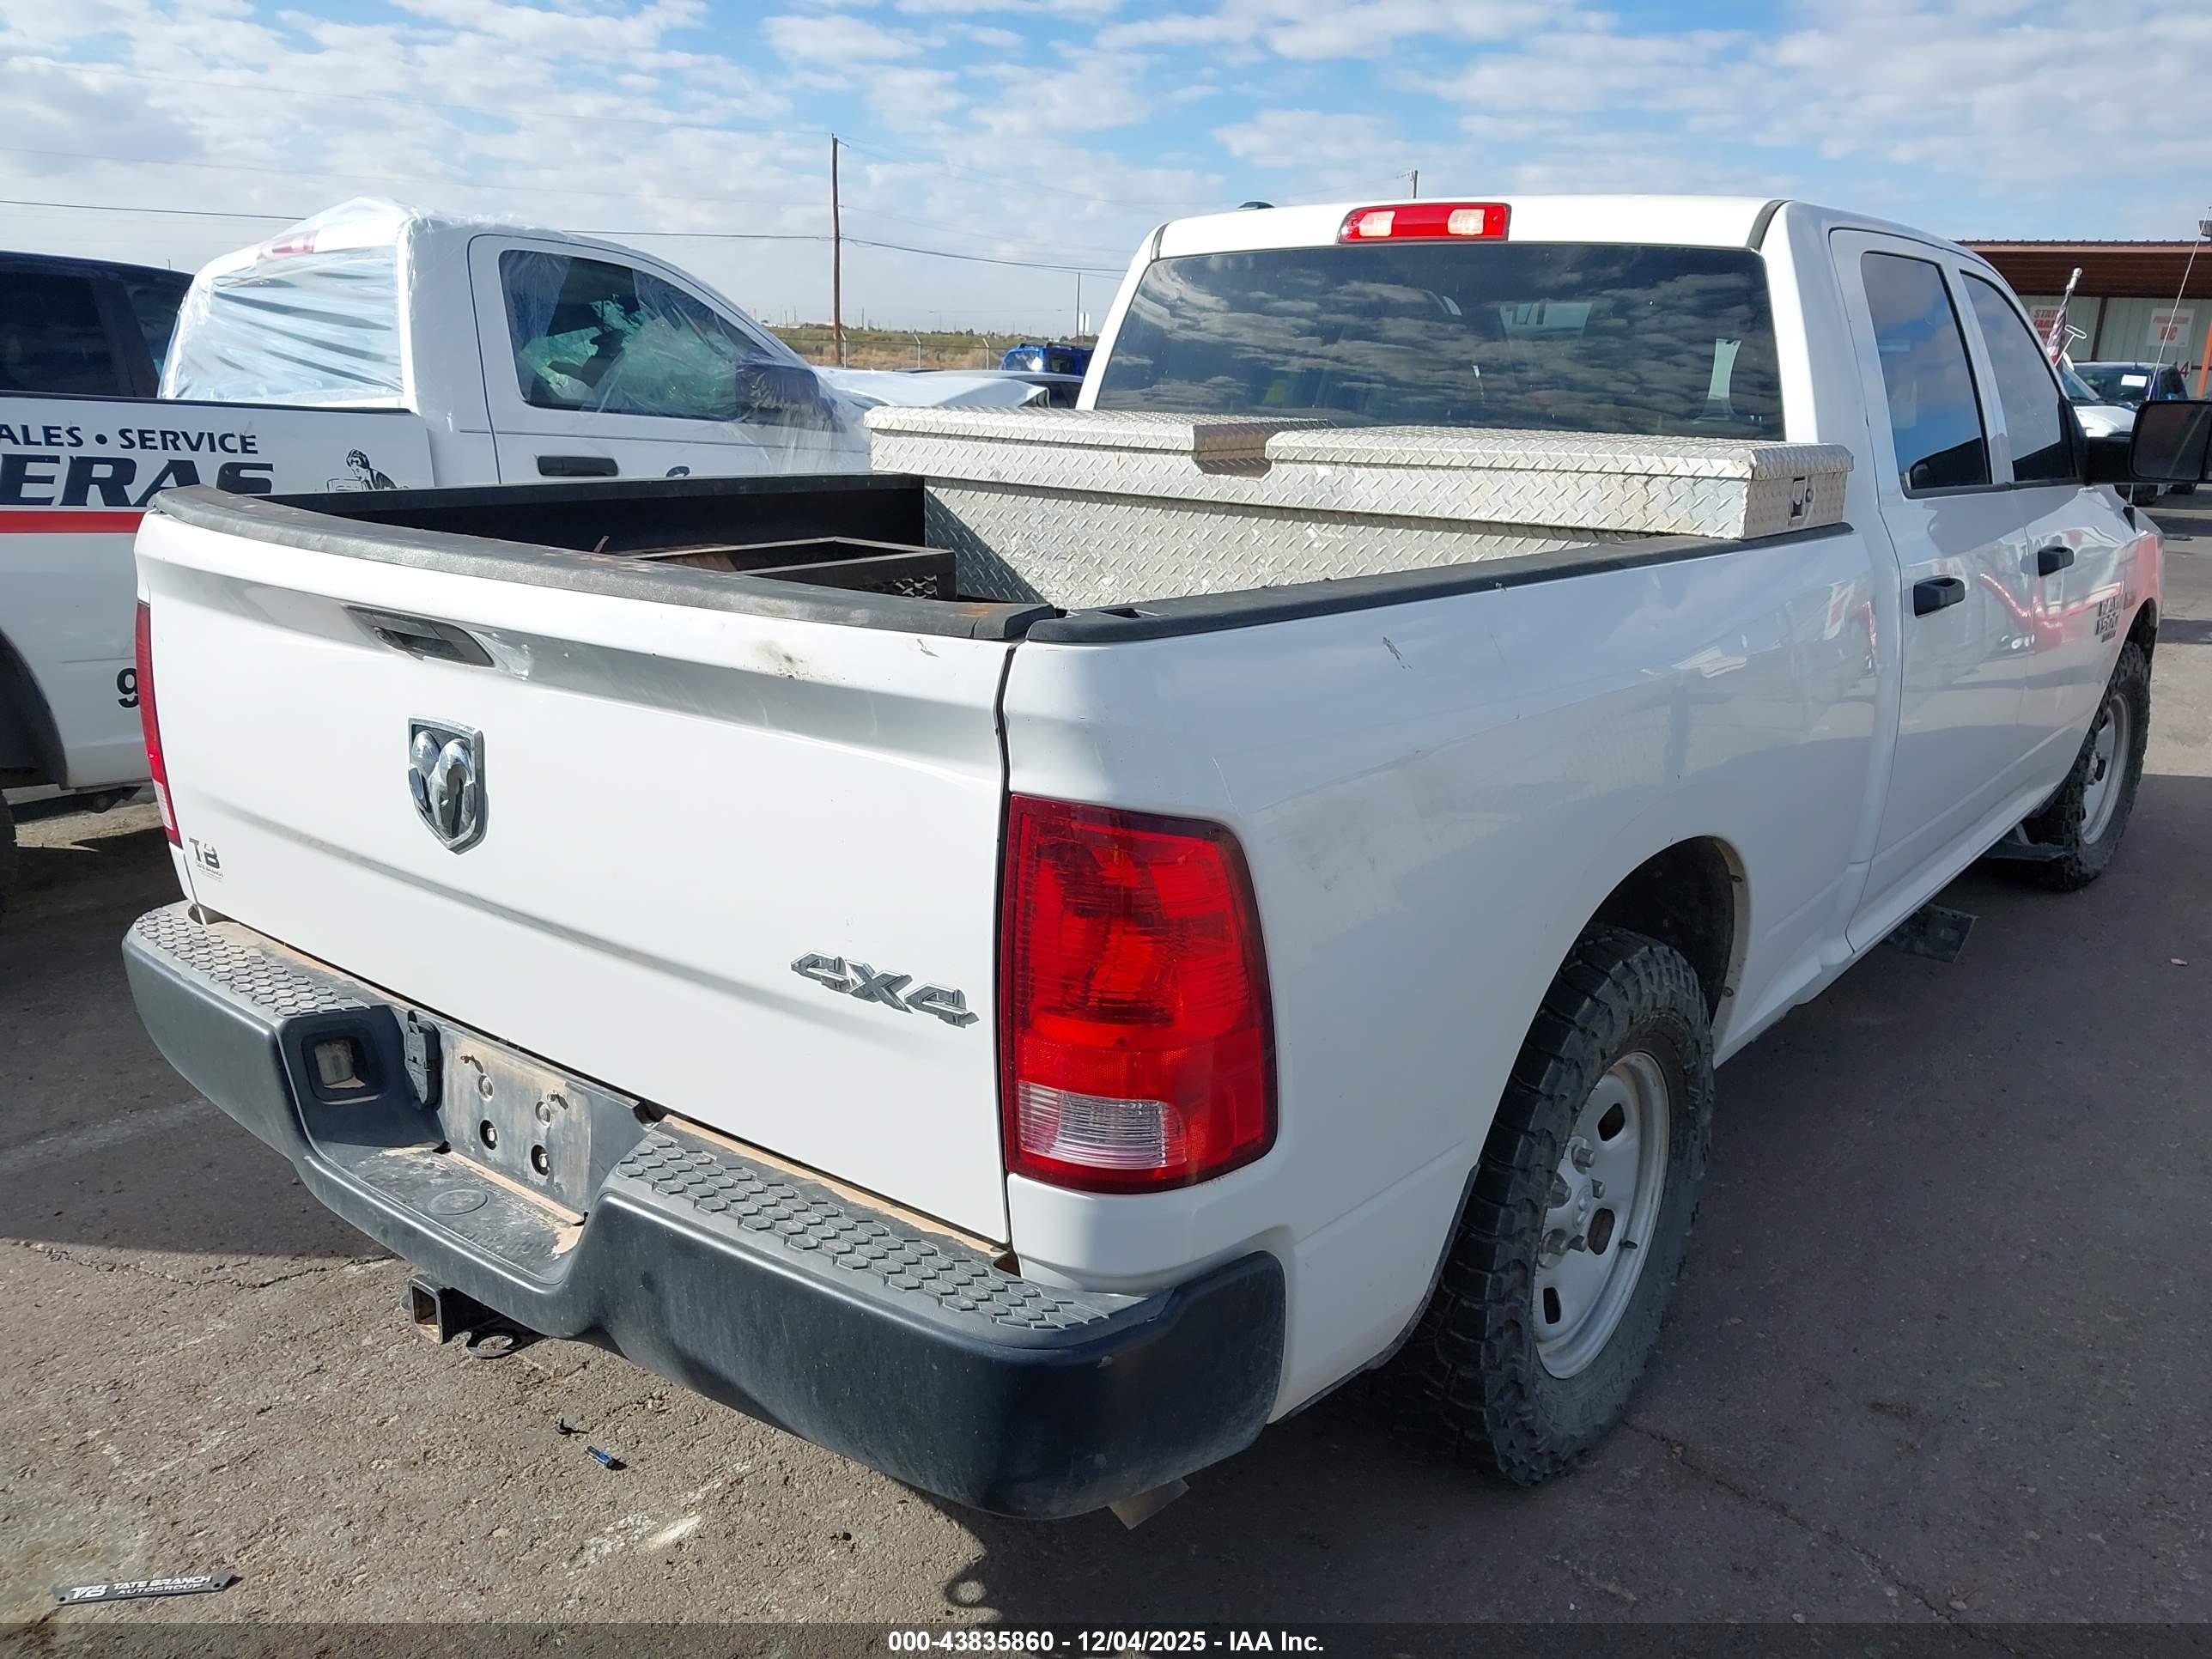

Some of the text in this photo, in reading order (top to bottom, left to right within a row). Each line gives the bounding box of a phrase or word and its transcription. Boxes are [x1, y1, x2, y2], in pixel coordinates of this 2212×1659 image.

[2033, 309, 2059, 319] STAT
[118, 428, 258, 454] SERVICE
[113, 1575, 212, 1591] TATE BRANCH
[116, 1583, 203, 1595] AUTOGROUP
